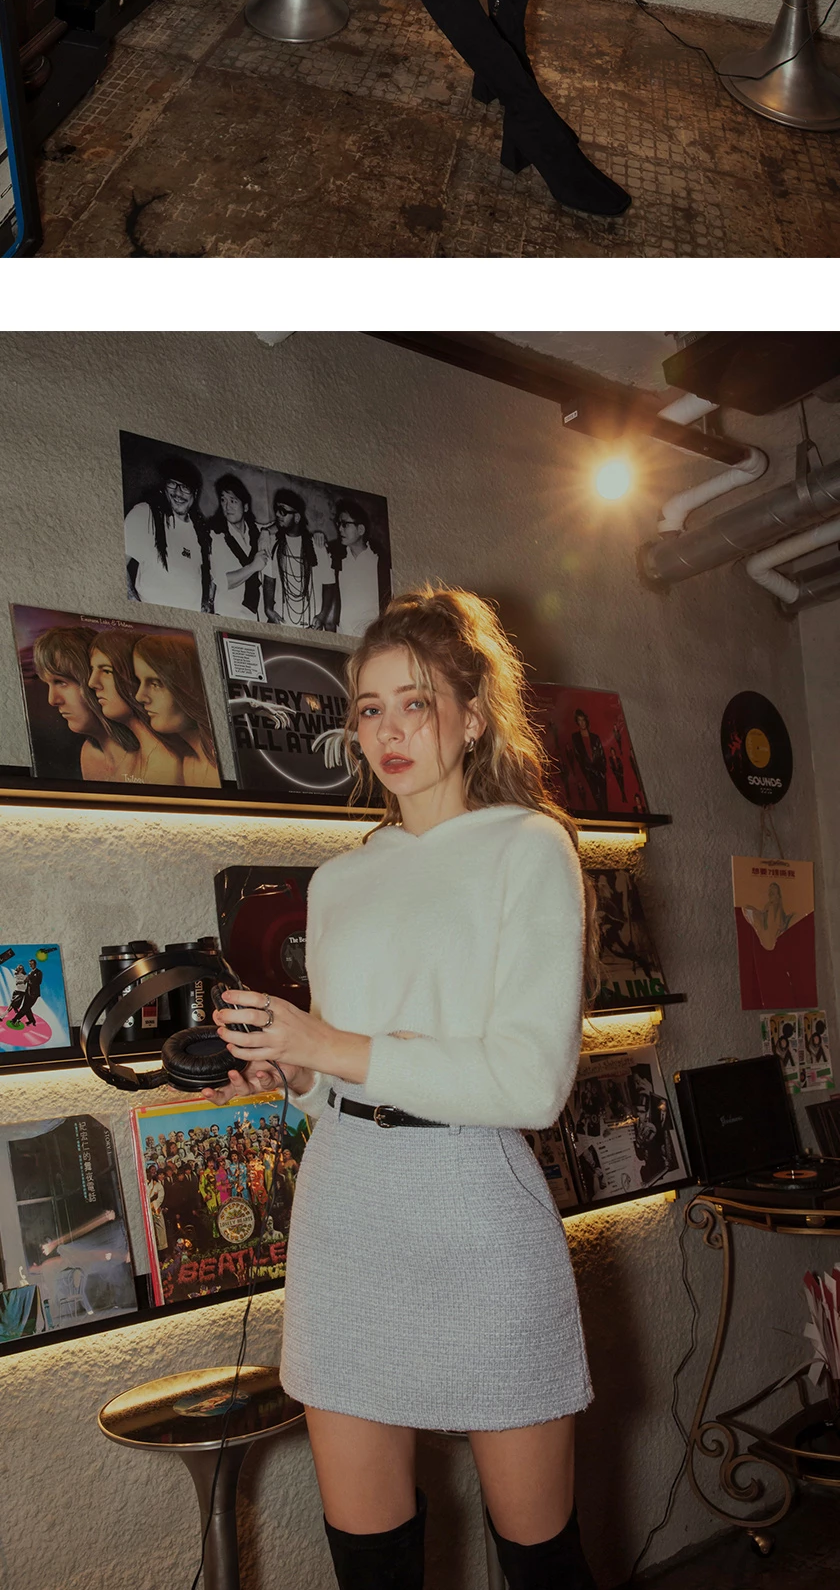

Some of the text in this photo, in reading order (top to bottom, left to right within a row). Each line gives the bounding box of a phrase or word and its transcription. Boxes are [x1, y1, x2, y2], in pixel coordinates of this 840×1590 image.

[236, 728, 283, 752] ALL
[748, 775, 783, 788] SOUNDS
[177, 1241, 288, 1285] BEATLE
